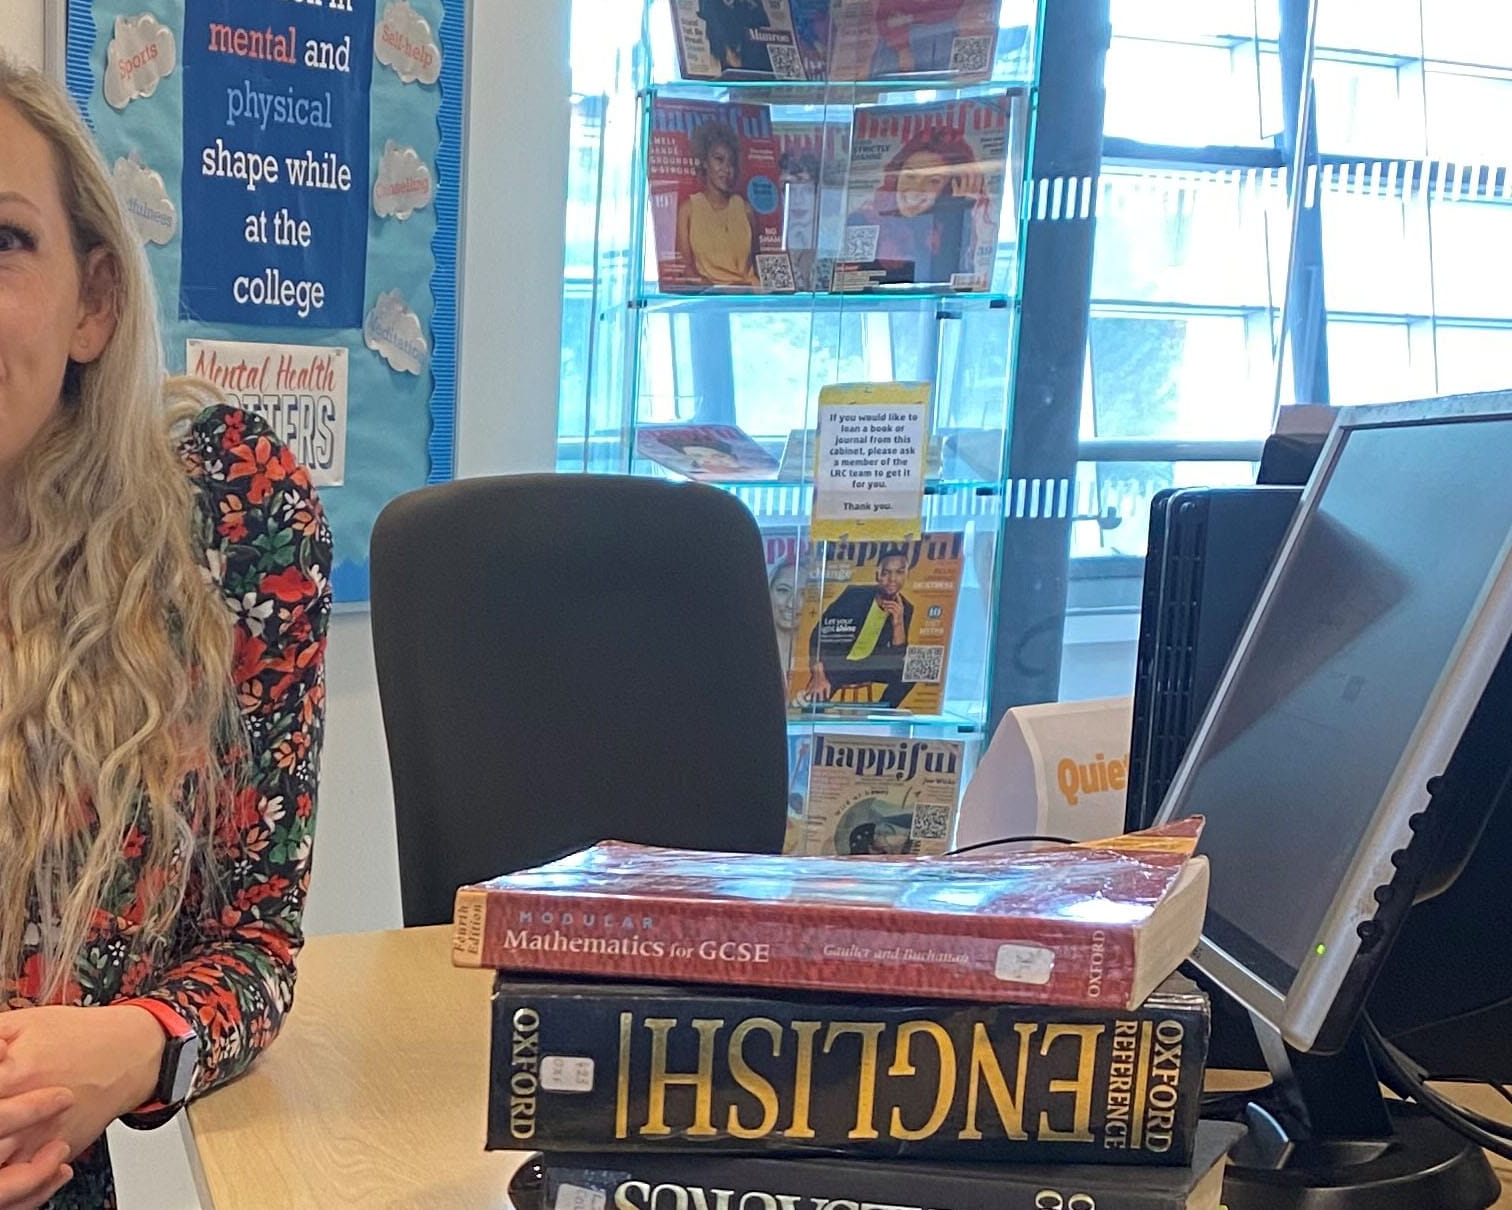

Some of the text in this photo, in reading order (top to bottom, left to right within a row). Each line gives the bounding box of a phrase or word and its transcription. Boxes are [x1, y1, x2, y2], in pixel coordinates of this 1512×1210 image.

[208, 22, 351, 73] mental and
[382, 24, 433, 69] Self-help
[749, 28, 790, 43] Munroe
[119, 44, 158, 80] Sports
[226, 80, 332, 131] physical
[202, 138, 352, 191] shape while
[245, 208, 312, 248] at the
[233, 268, 325, 318] college
[195, 350, 336, 392] Mental Health
[830, 413, 918, 424] If you would like to
[841, 424, 861, 433] loan
[870, 424, 893, 433] book
[895, 425, 905, 433] or
[829, 446, 915, 457] cabinet, please ask
[835, 435, 911, 446] journal from this
[830, 468, 910, 479] LRC team to get it
[841, 458, 879, 466] member
[880, 457, 890, 466] of
[893, 458, 908, 466] the
[852, 480, 887, 490] for you.
[843, 502, 894, 512] Thank you.
[824, 618, 854, 627] Let your
[836, 624, 857, 633] shine
[814, 736, 957, 782] happiful
[1057, 752, 1128, 806] Quie
[454, 905, 469, 953] Fourth
[467, 904, 483, 955] Edition
[519, 911, 654, 930] MODULAR
[504, 929, 770, 964] Mathematics for GCSE
[823, 943, 970, 965] Gaulter and Buchanan
[1088, 929, 1106, 998] OXFORD
[510, 1007, 540, 1140] OXFORD
[639, 1017, 1106, 1143] ENGLISH
[1103, 1019, 1139, 1150] REFERENCE
[1144, 1018, 1185, 1153] OXFORD
